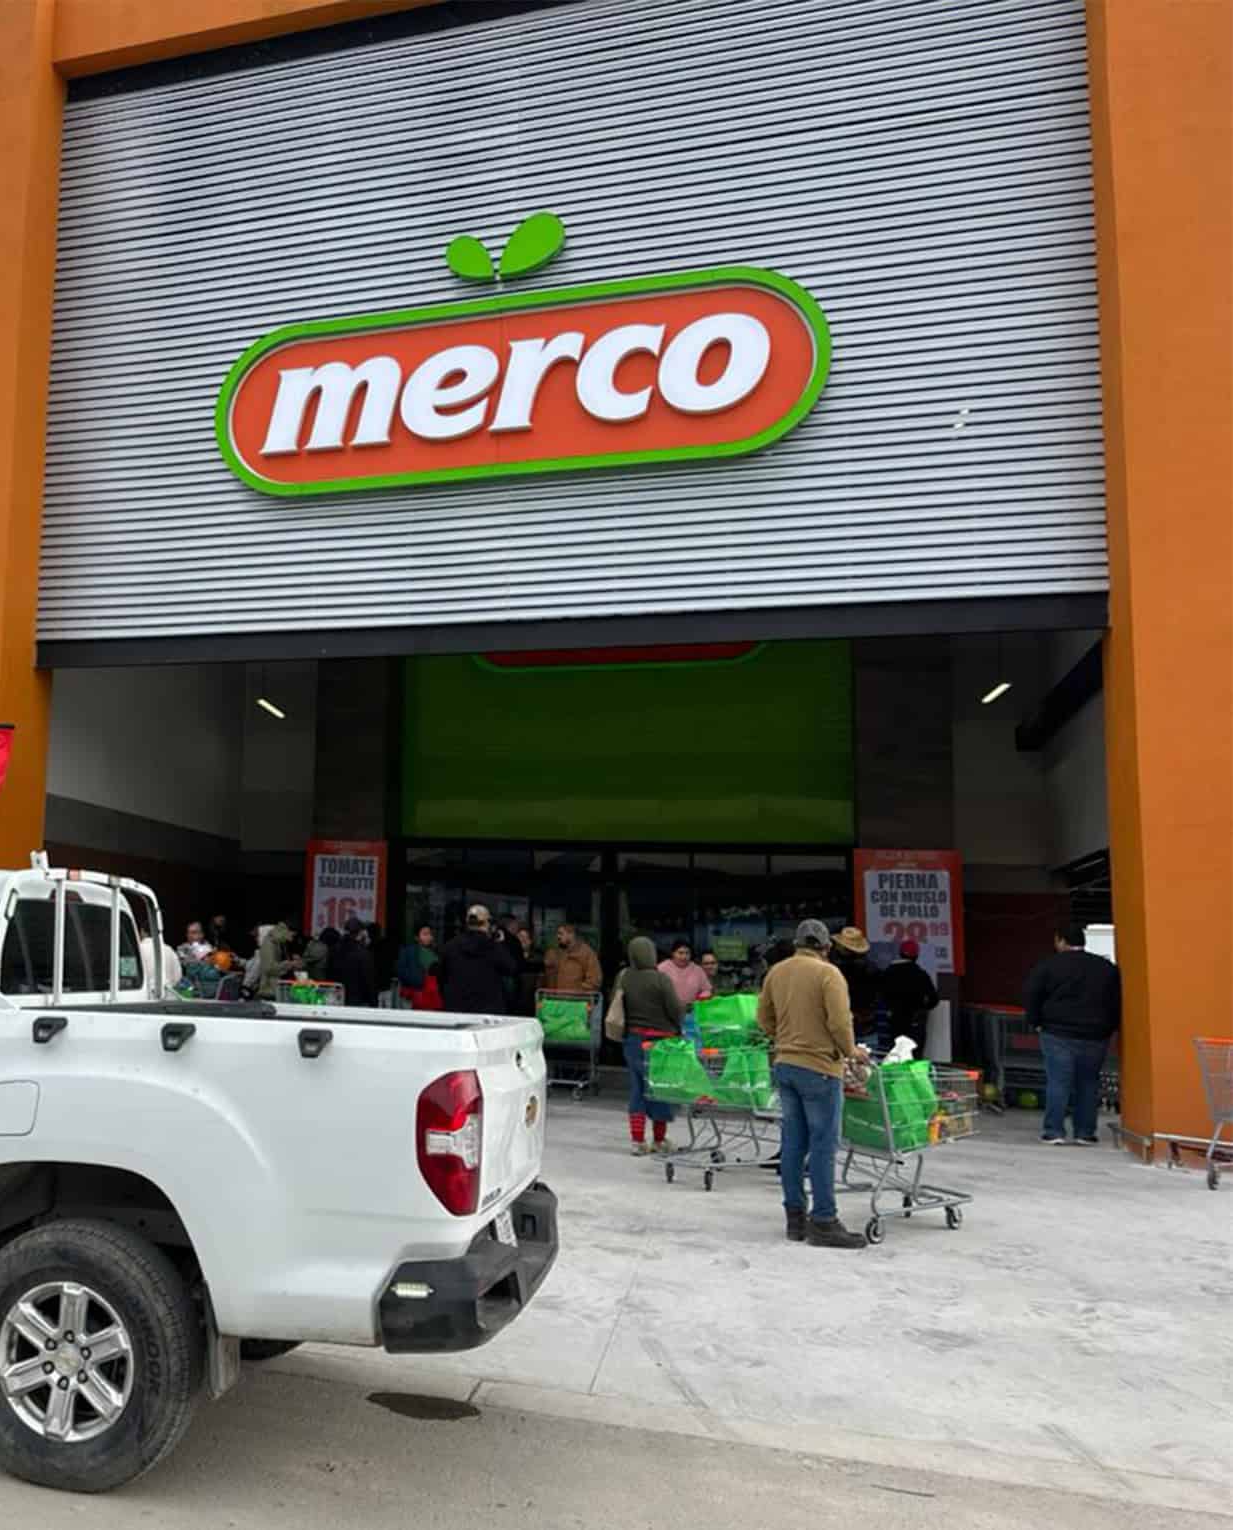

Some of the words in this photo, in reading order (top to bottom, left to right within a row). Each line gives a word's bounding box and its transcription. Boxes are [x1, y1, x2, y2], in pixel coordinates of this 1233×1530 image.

[259, 311, 772, 457] merco
[317, 857, 375, 876] TOMATE
[877, 872, 940, 889] PIERNA
[870, 890, 899, 904] CON
[901, 890, 948, 904] MUSLO
[879, 904, 896, 918] DE
[899, 904, 940, 919] POLLO
